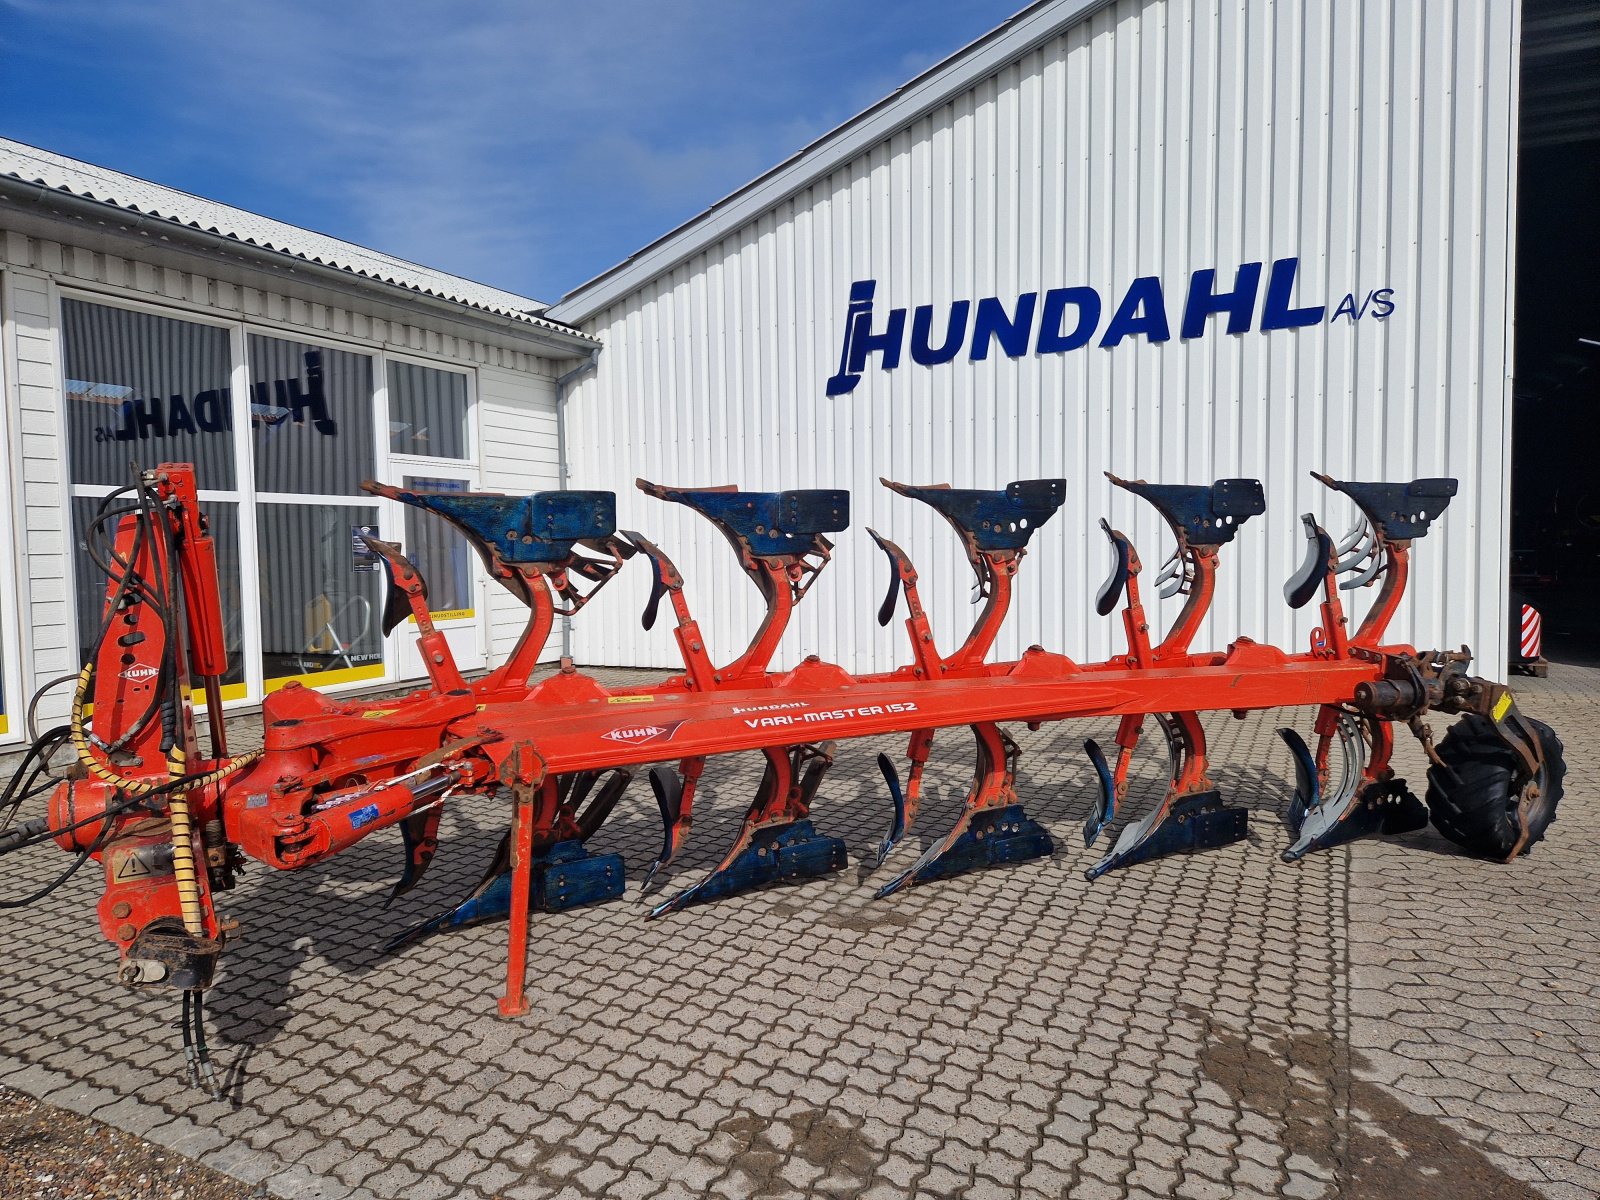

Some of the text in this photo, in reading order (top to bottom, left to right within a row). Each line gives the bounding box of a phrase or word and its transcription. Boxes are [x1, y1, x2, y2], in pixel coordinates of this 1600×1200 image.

[1330, 288, 1395, 324] A/S
[124, 668, 156, 678] KUHN
[744, 702, 918, 729] VARI-MASTER 152
[610, 726, 658, 740] KUHN
